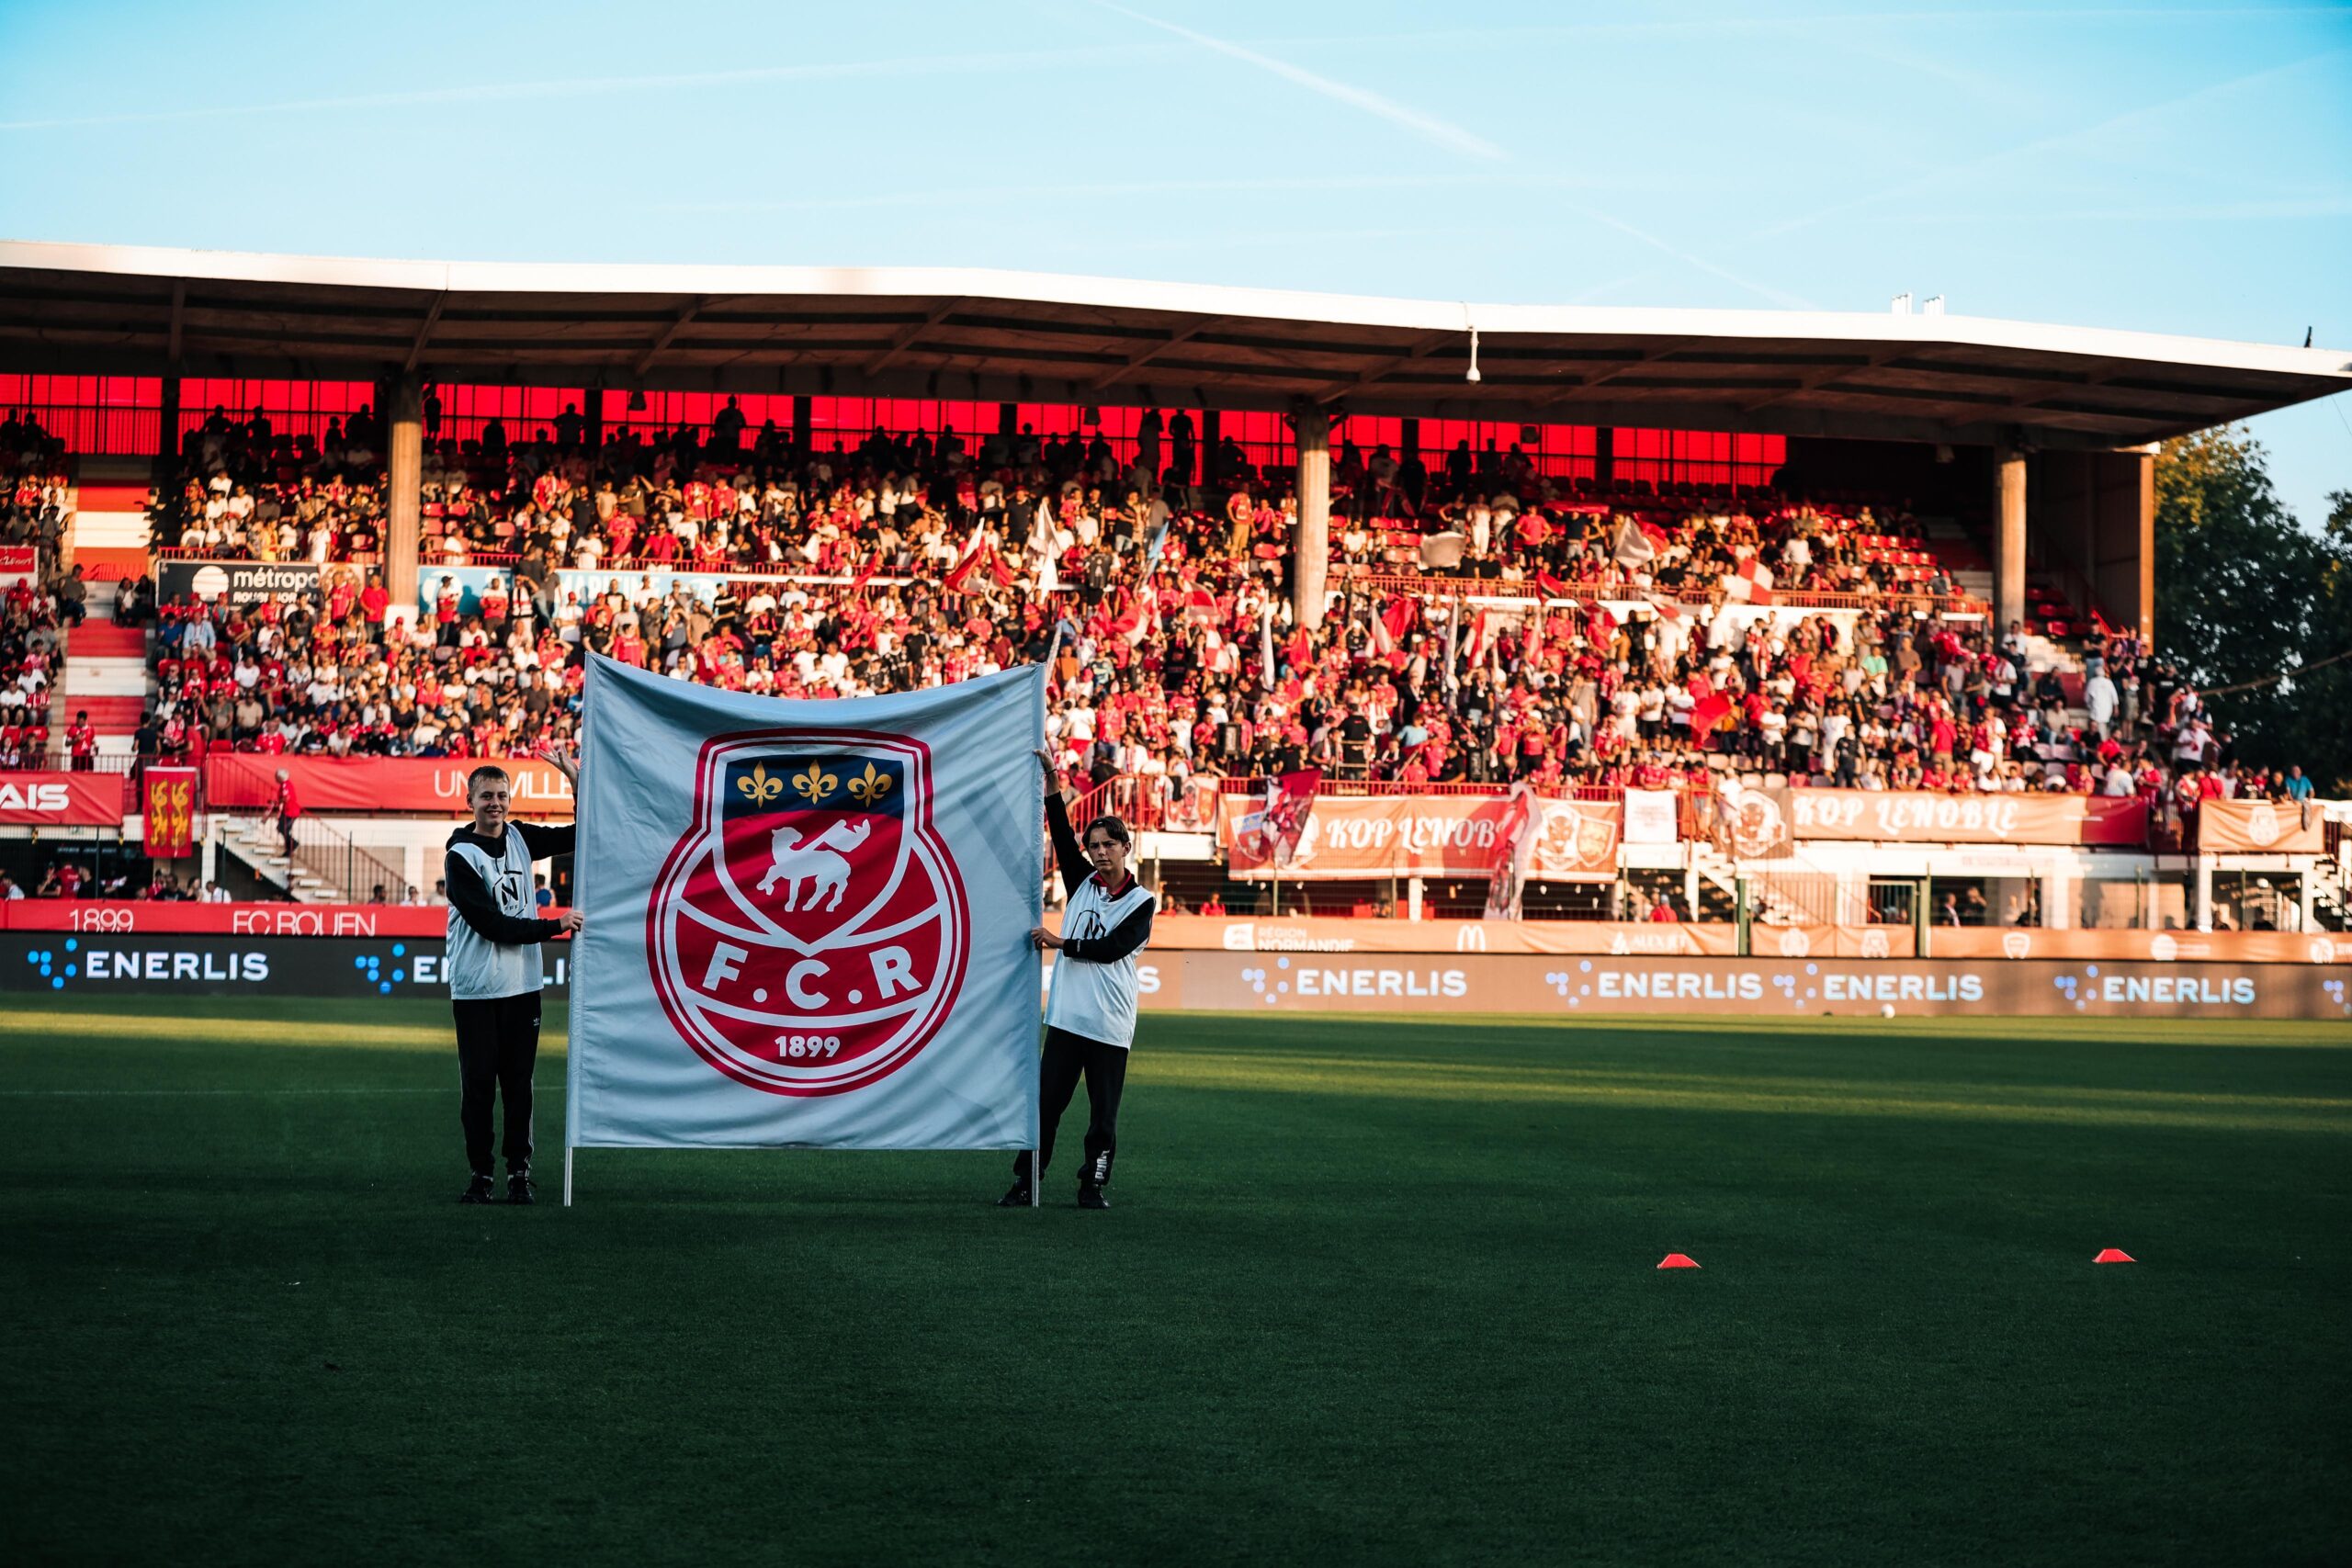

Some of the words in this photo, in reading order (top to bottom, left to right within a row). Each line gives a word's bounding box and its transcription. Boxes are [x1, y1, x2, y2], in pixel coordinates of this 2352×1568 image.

[1792, 795, 1864, 826] KOP
[1876, 796, 2019, 838] LENOBLE
[1326, 818, 1393, 849] KOP
[69, 908, 134, 933] 1899
[232, 910, 270, 936] FC
[86, 950, 269, 981] ENERLIS
[1296, 969, 1467, 998] ENERLIS
[1598, 971, 1764, 999] ENERLIS
[1823, 974, 1984, 1001] ENERLIS
[2103, 976, 2256, 1005] ENERLIS
[775, 1035, 841, 1058] 1899
